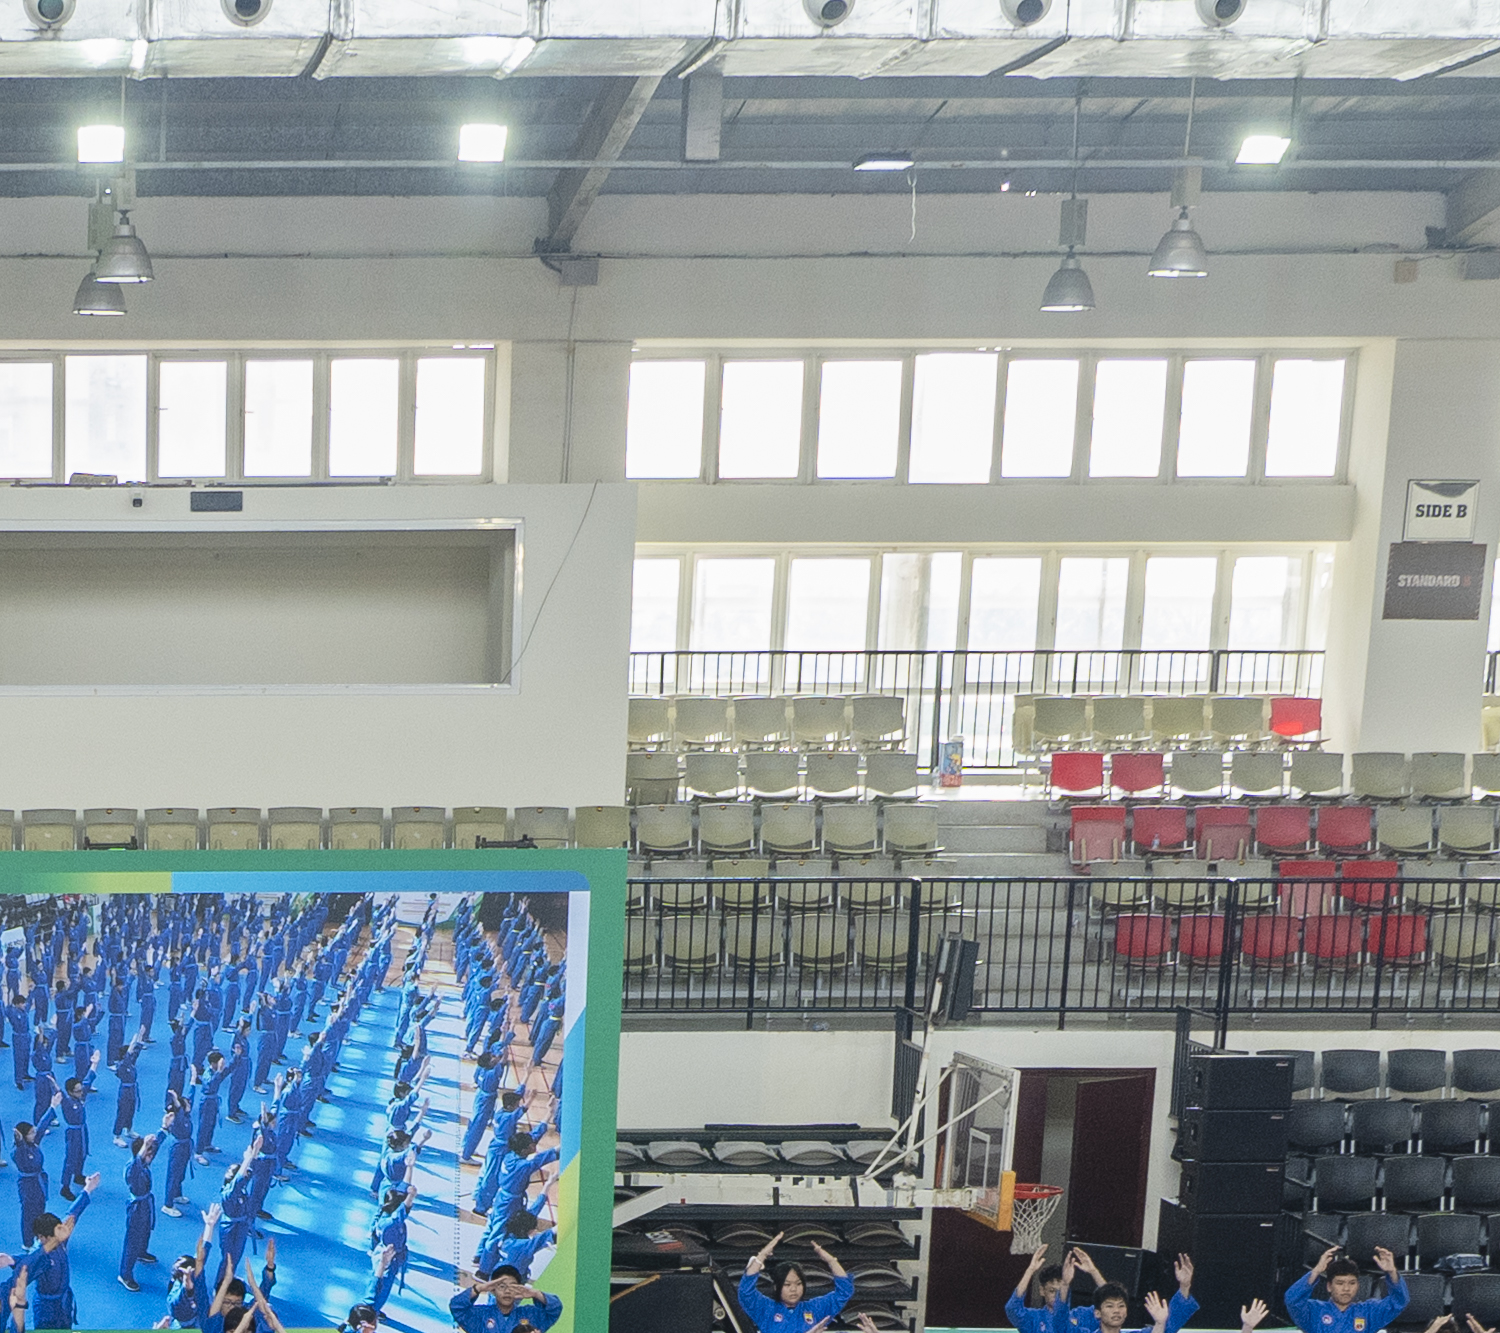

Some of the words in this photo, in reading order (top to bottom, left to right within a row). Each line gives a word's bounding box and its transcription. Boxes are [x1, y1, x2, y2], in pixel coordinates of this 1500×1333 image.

[1416, 504, 1454, 518] SIDE
[1456, 504, 1468, 518] B
[1398, 575, 1460, 587] STANDARD
